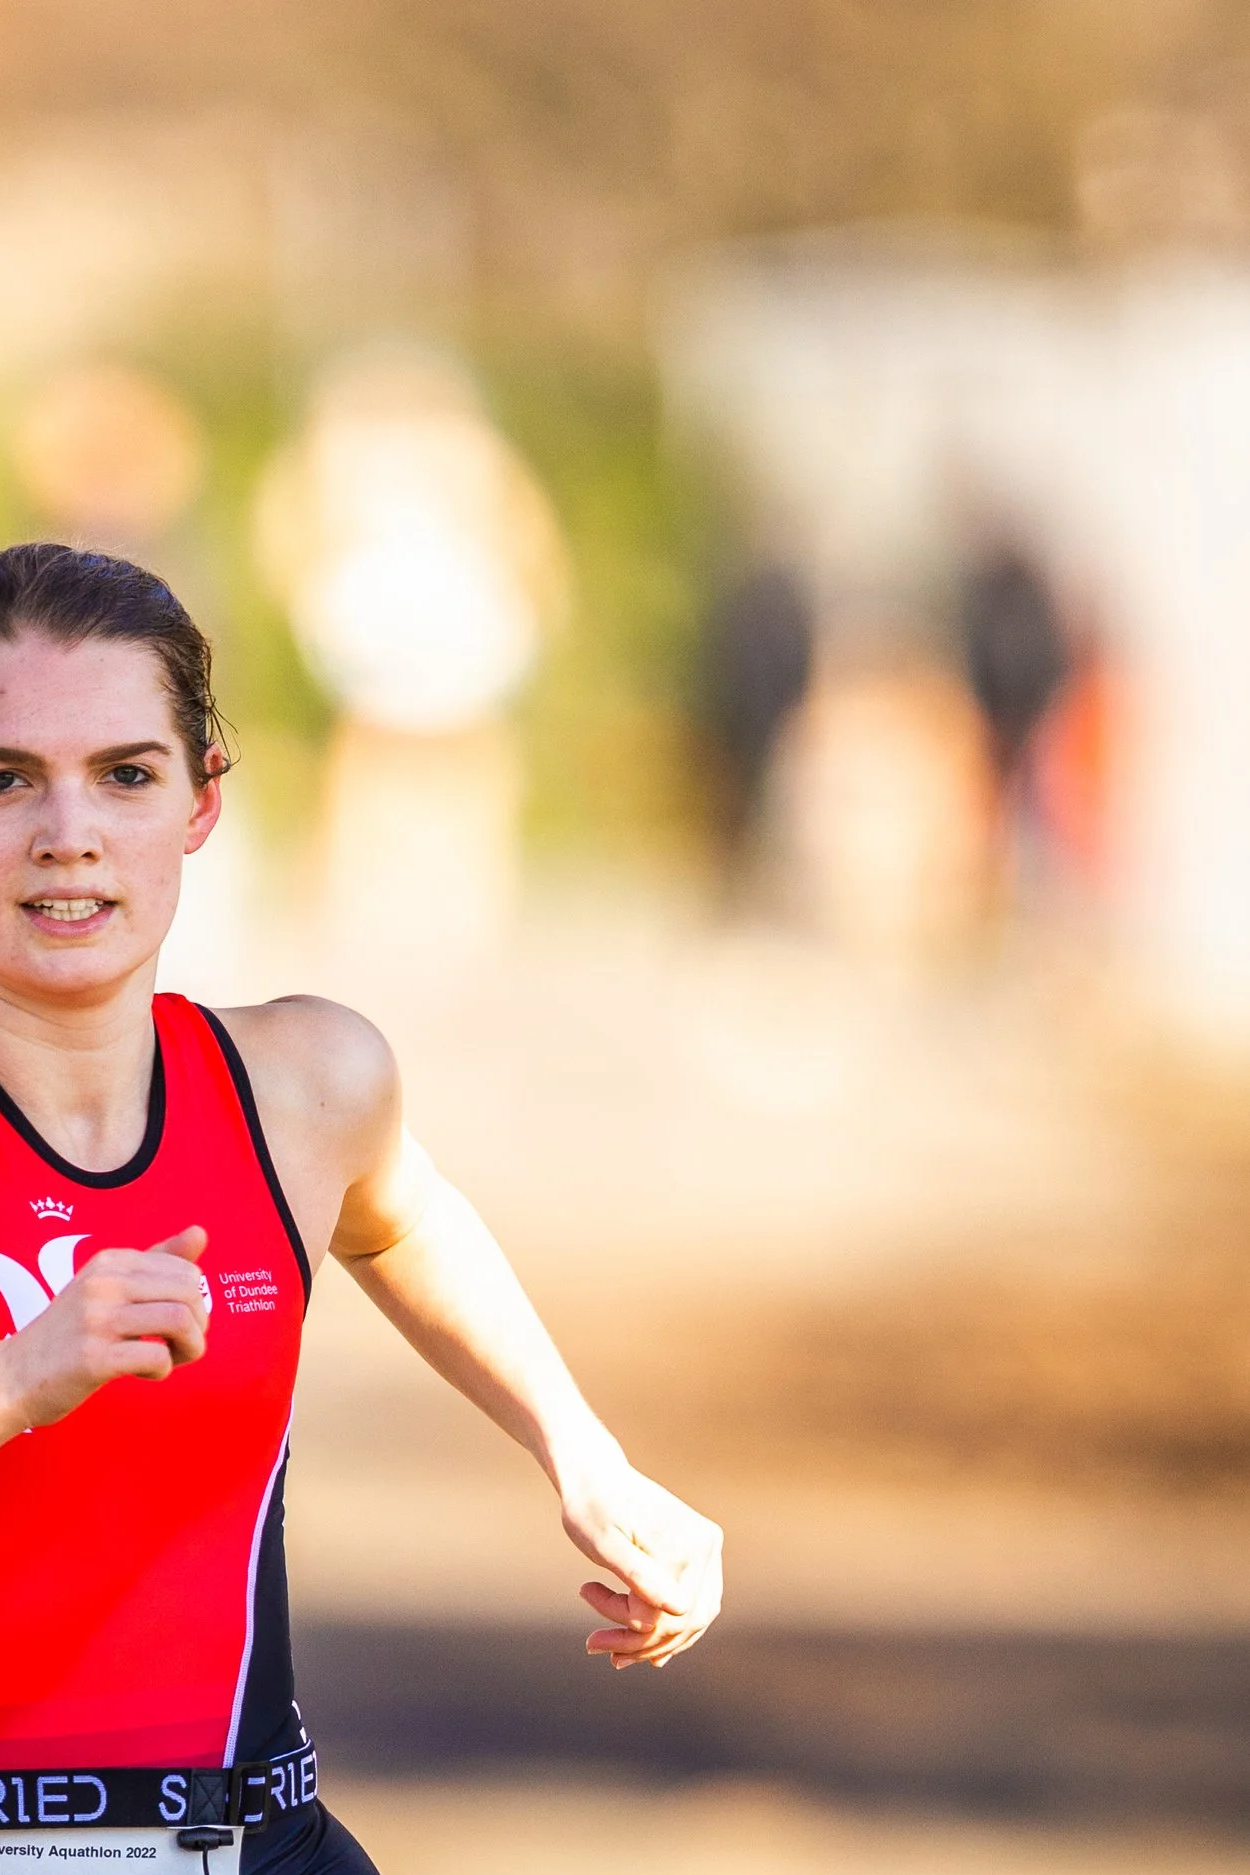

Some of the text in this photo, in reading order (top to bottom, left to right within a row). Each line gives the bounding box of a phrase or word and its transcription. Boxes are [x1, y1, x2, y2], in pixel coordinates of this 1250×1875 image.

[218, 1268, 272, 1285] University
[224, 1284, 278, 1299] of Dundee
[227, 1299, 276, 1313] Triathlon
[48, 1845, 122, 1860] Aquathlon
[126, 1847, 157, 1859] 2022
